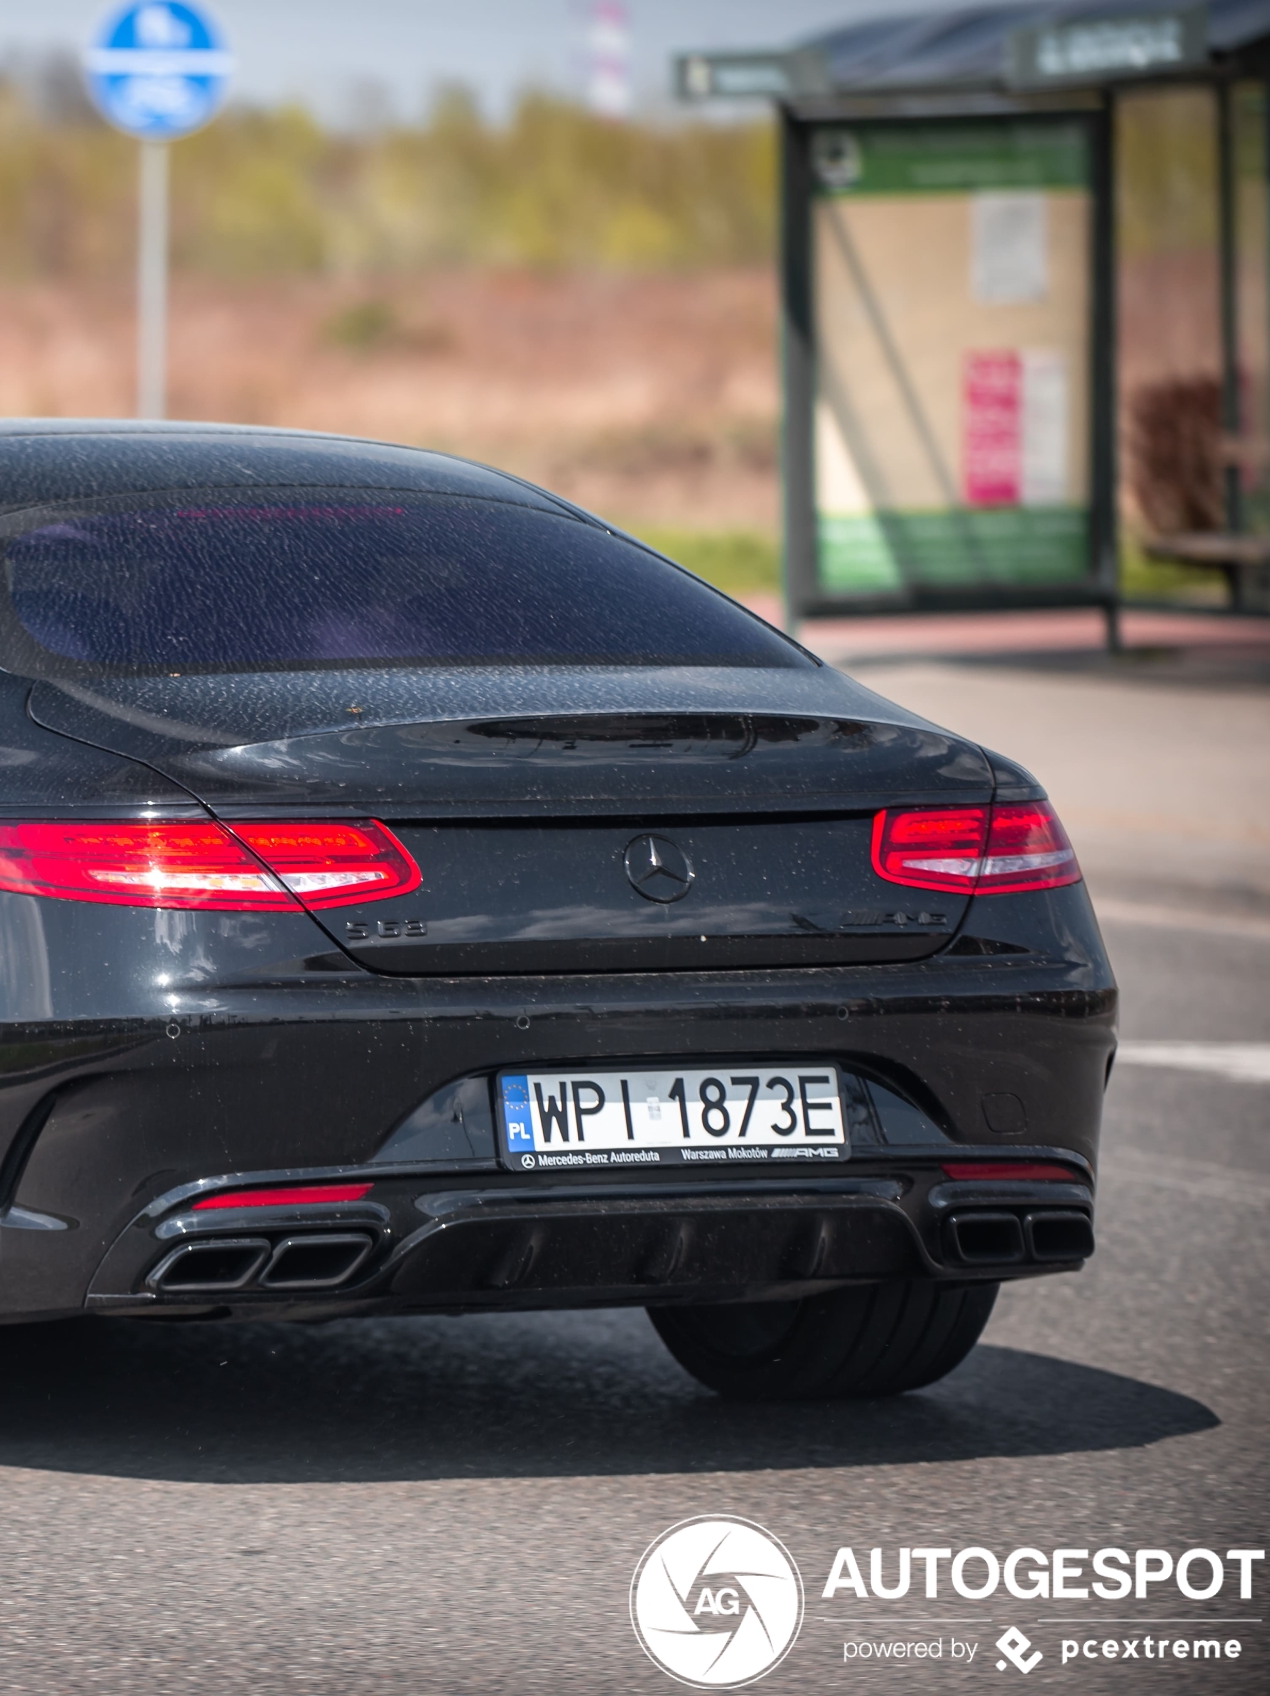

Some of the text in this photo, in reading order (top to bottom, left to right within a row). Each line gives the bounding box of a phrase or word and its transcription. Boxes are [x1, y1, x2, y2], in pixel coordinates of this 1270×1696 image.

[346, 921, 369, 940] S
[533, 1075, 836, 1143] WPI 1873E
[508, 1122, 531, 1140] PL
[538, 1146, 840, 1167] Mercedes-Benz Autoreduta Warszawa Mokotów AMG
